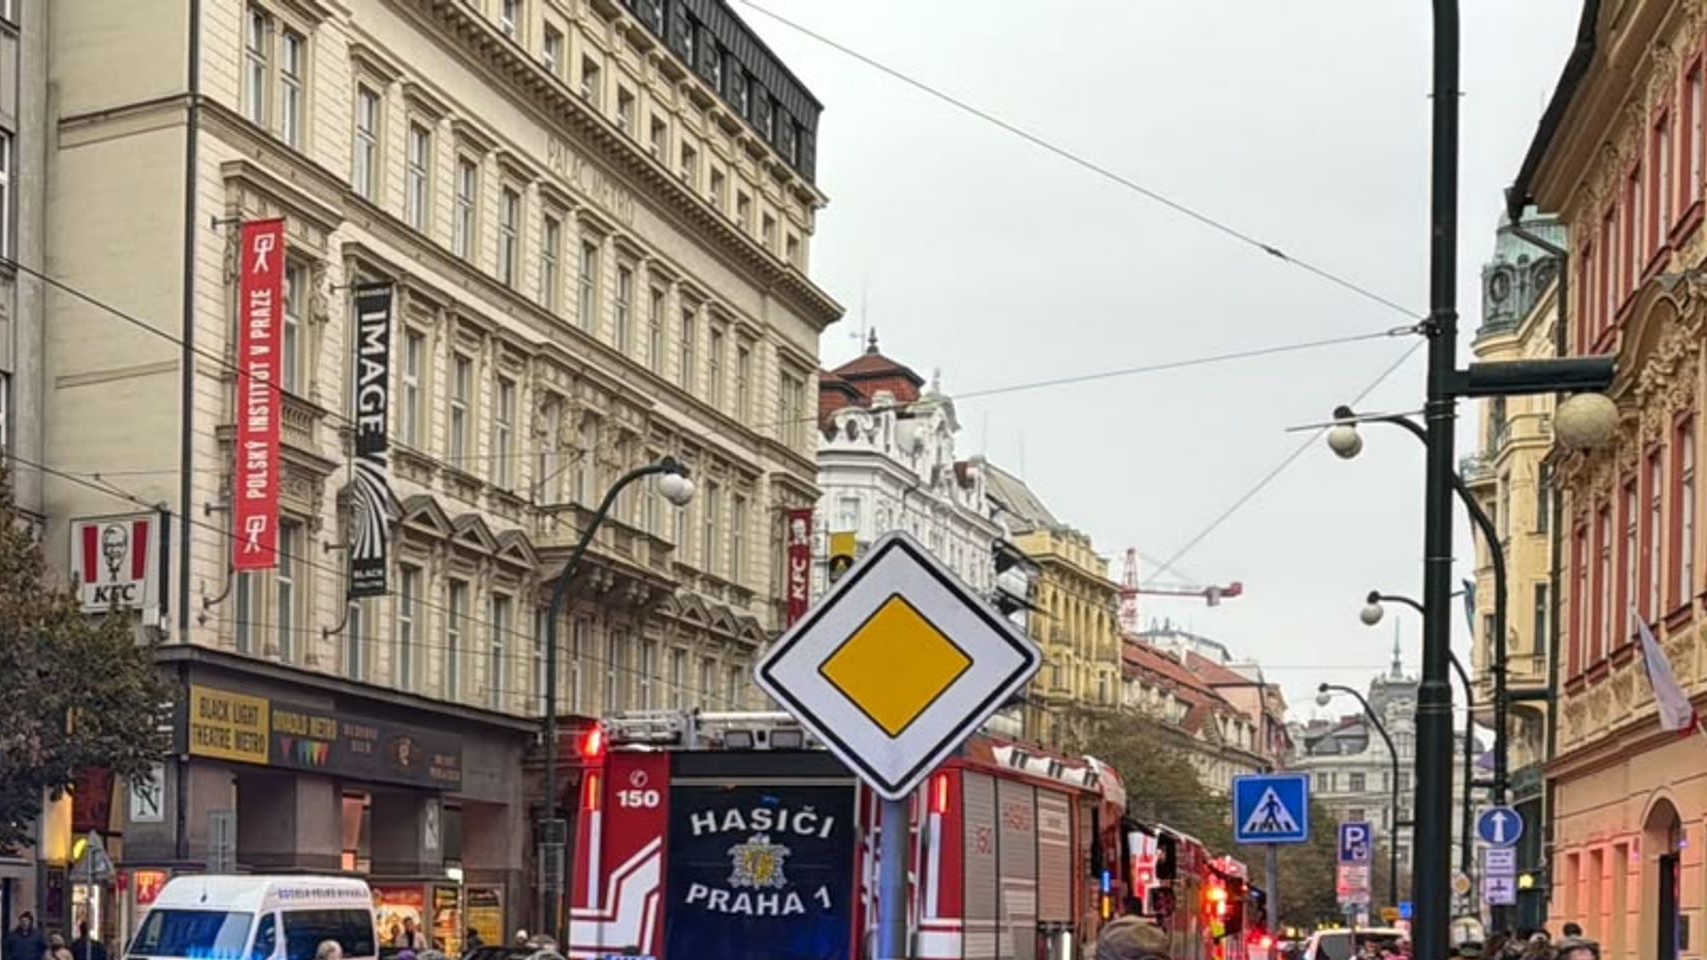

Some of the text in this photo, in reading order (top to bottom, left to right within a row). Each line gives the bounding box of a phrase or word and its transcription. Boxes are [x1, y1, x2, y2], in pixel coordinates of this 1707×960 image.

[359, 310, 387, 437] IMAGE
[245, 288, 272, 499] POLSKÝ INSTITUT V PRAZE
[94, 583, 136, 604] KFC
[792, 557, 807, 600] KFC
[199, 697, 258, 727] BLACK LIGHT
[235, 728, 265, 755] METRO
[616, 790, 660, 808] 150
[690, 806, 835, 838] HASIČI
[685, 883, 833, 916] PRAHA 1
